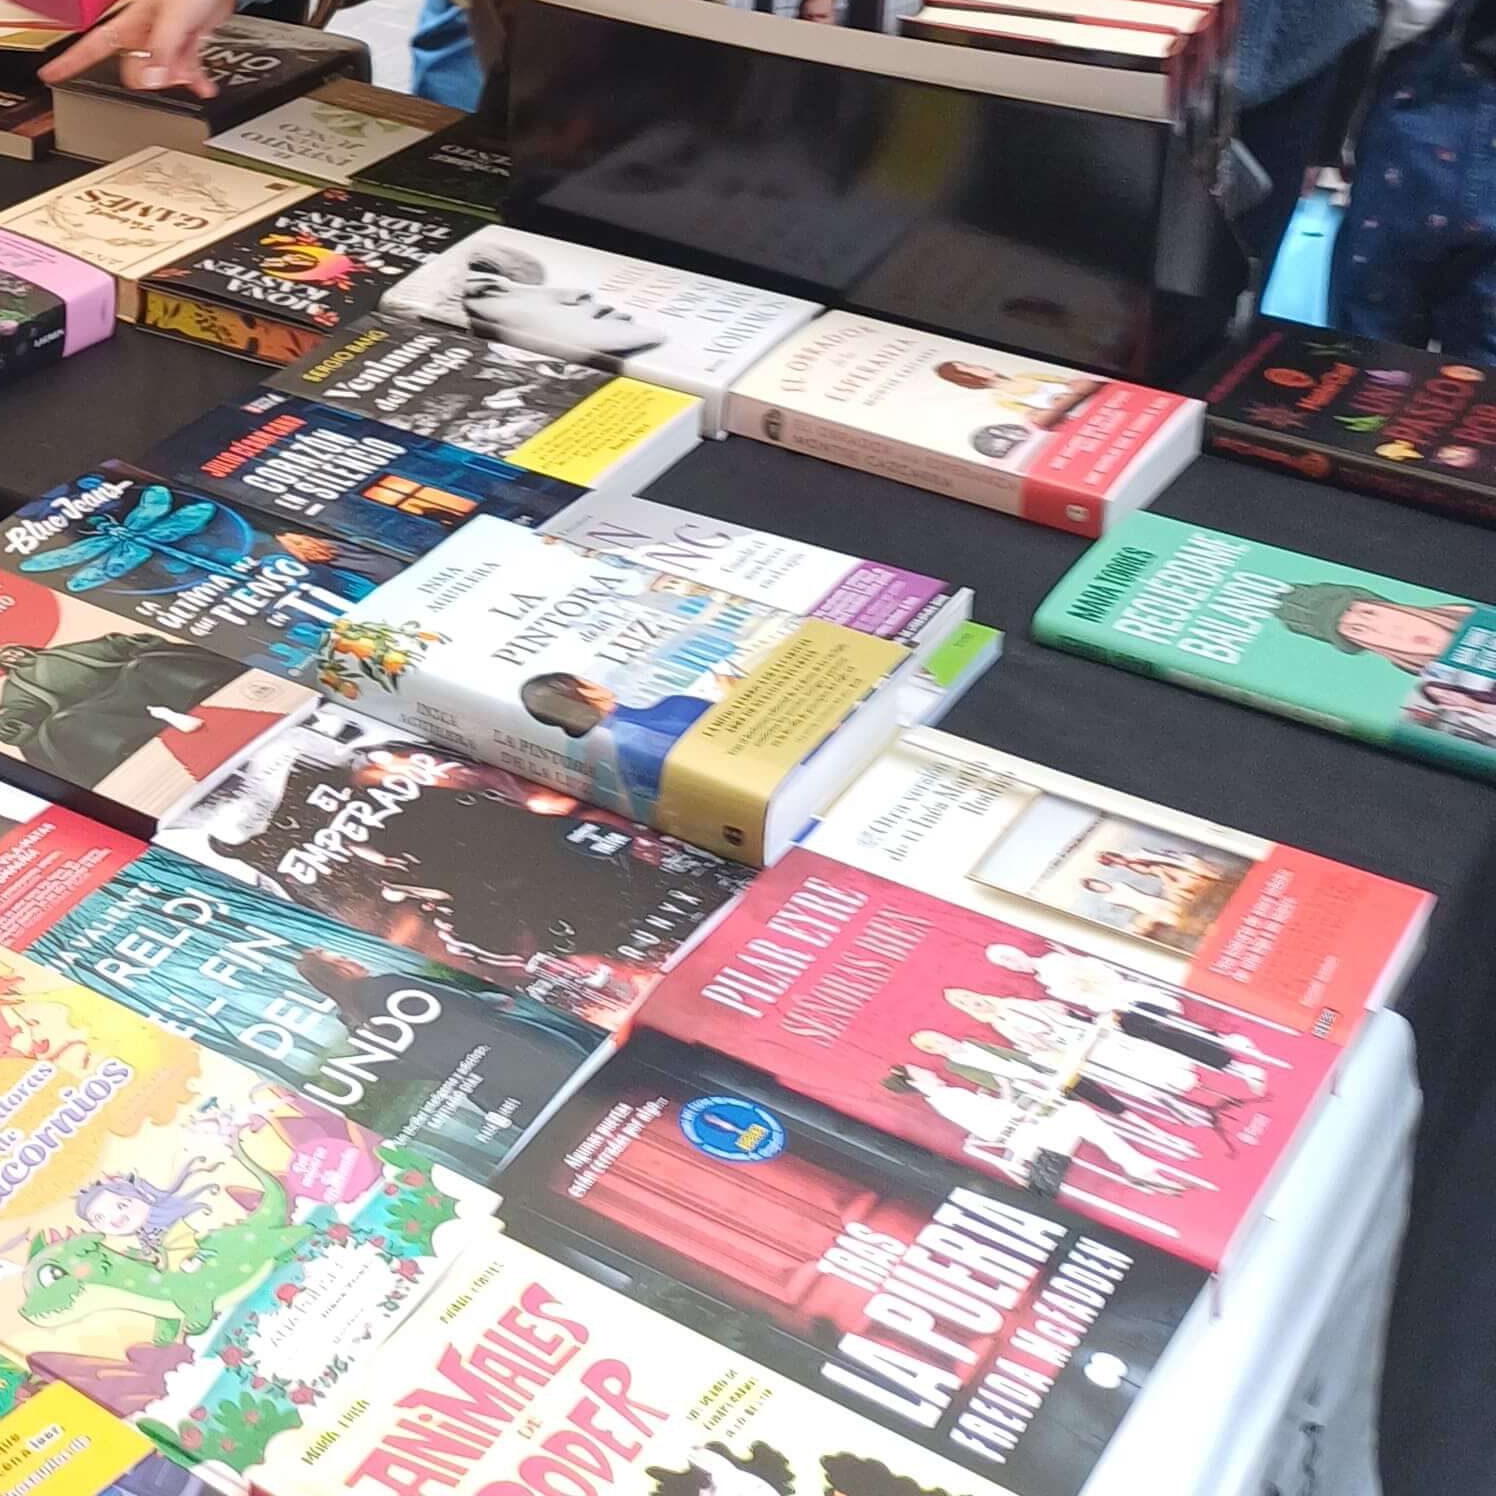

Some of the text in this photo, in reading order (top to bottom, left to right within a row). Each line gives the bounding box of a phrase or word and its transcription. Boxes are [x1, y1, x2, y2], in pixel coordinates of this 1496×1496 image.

[74, 189, 210, 231] GAMES
[193, 259, 331, 301] KASTEN
[302, 329, 391, 384] SERGIO BANG
[322, 334, 442, 399] Venimos
[374, 347, 474, 413] del fuego
[242, 427, 359, 494] CORAZÓN
[293, 436, 408, 501] SILENCIO
[4, 479, 135, 555] Blue Jeans
[209, 556, 310, 627] PIENSO
[487, 591, 548, 622] LA
[490, 574, 627, 668] PINTORA
[595, 618, 661, 666] LUZ
[276, 751, 465, 888] EMPERADOR
[198, 925, 293, 991] FIN
[699, 937, 818, 1020] PILAR
[765, 875, 871, 949] EYRE
[237, 990, 338, 1061] DEL
[303, 989, 443, 1115] UNDO
[563, 1131, 601, 1172] Algunas
[594, 1102, 635, 1141] puertas
[567, 1167, 595, 1199] están
[816, 1220, 909, 1293] TRAS
[819, 1185, 1070, 1430] LA PUERTA
[344, 1281, 591, 1496] ANIMALES
[949, 1355, 1057, 1465] FREIDA
